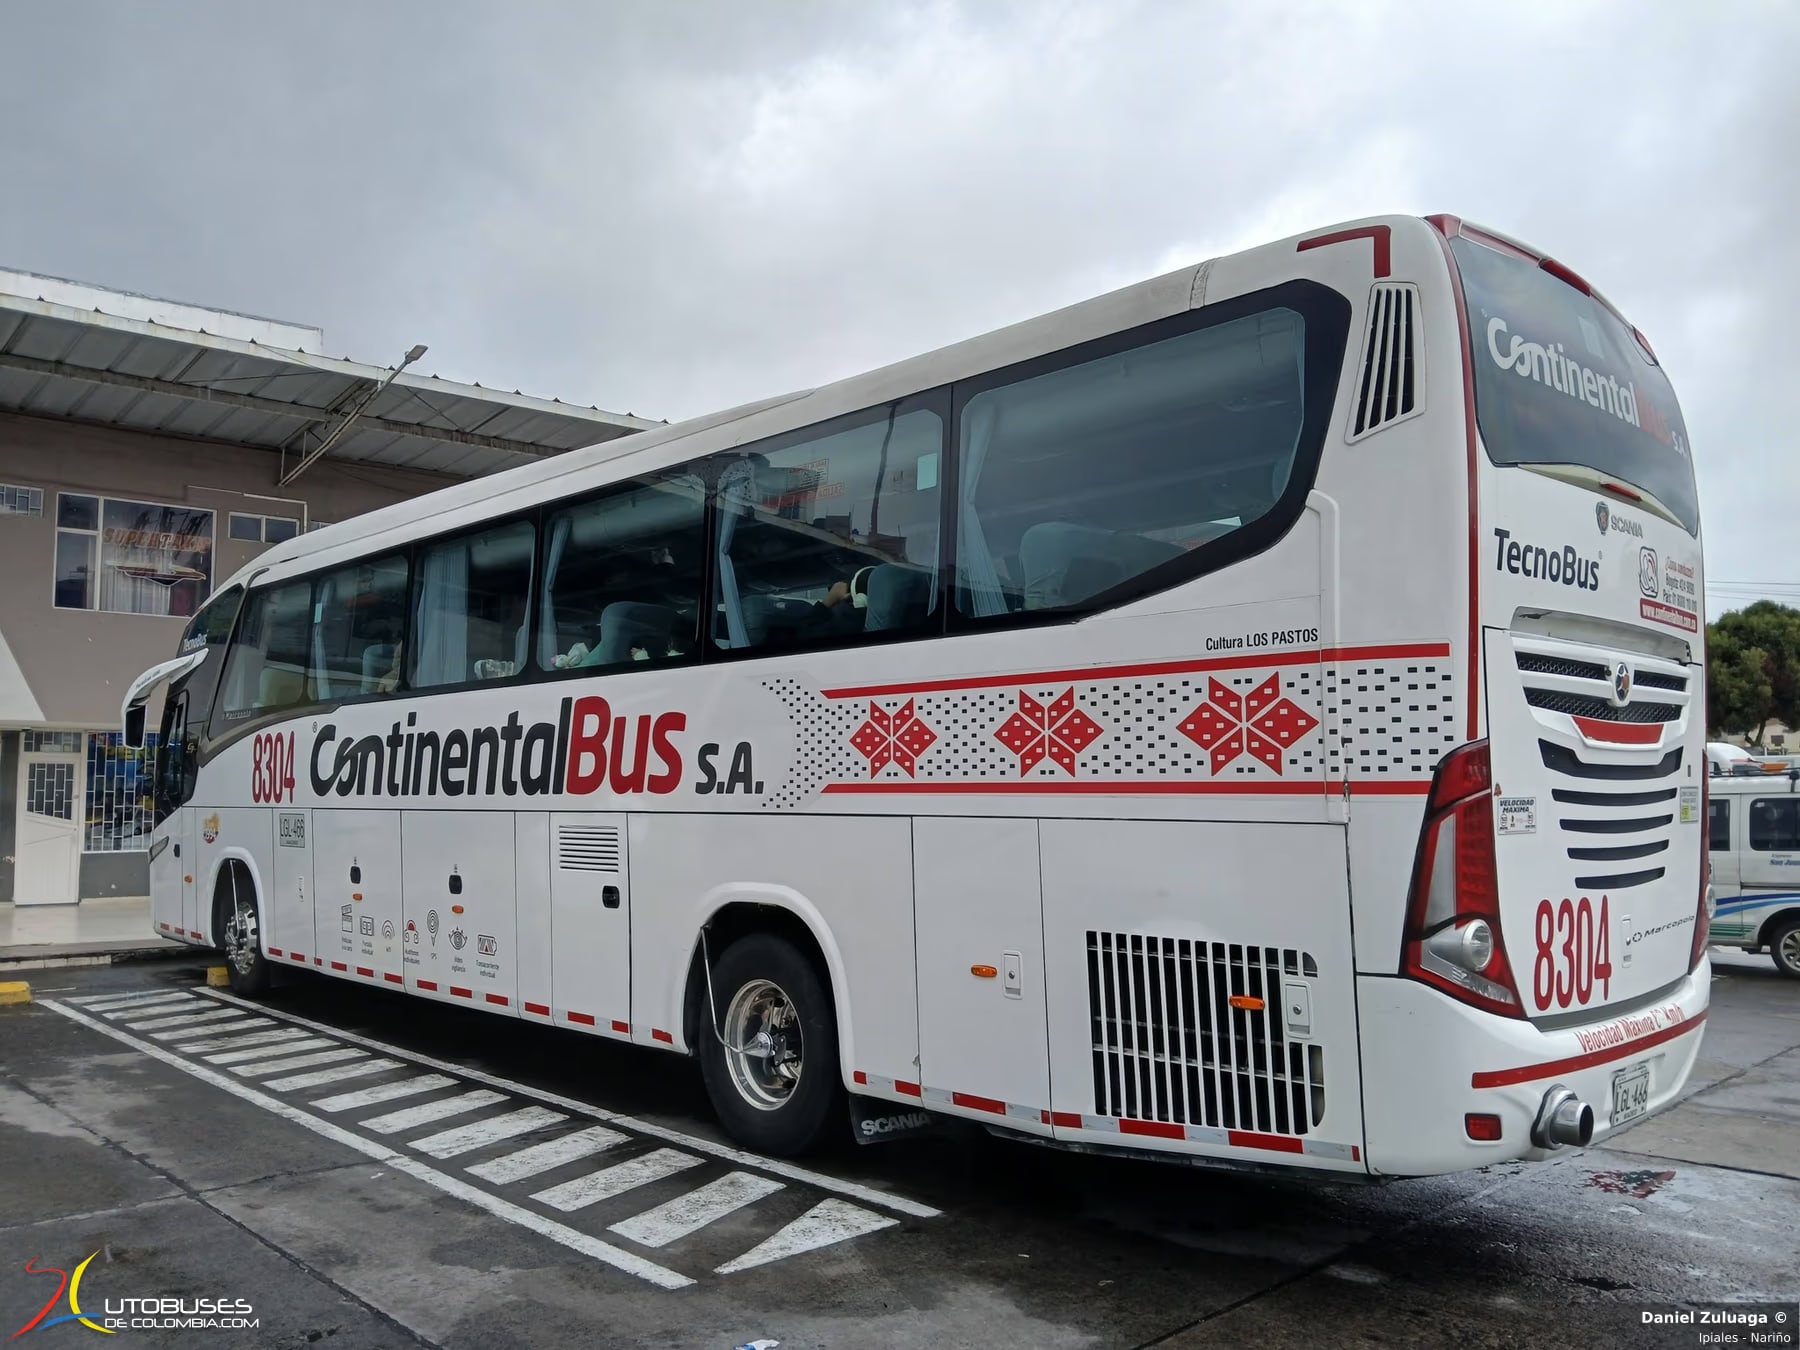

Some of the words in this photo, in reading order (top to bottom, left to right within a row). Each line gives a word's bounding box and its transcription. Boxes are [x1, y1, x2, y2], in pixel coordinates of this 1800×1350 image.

[1611, 514, 1643, 538] SCANIA
[1494, 527, 1599, 591] TecnoBus
[1206, 637, 1243, 650] Cultura
[1246, 632, 1269, 647] LOS
[1272, 628, 1319, 645] PASTOS
[251, 730, 297, 805] 8304
[695, 741, 765, 795] S.A.
[1500, 799, 1534, 807] VELOCIDAD
[1644, 915, 1696, 937] Marcopolo
[1533, 894, 1612, 1011] 8304
[1574, 1022, 1624, 1053] Velocidad
[1614, 1080, 1648, 1114] LGL-466
[861, 1113, 930, 1136] SCANIA
